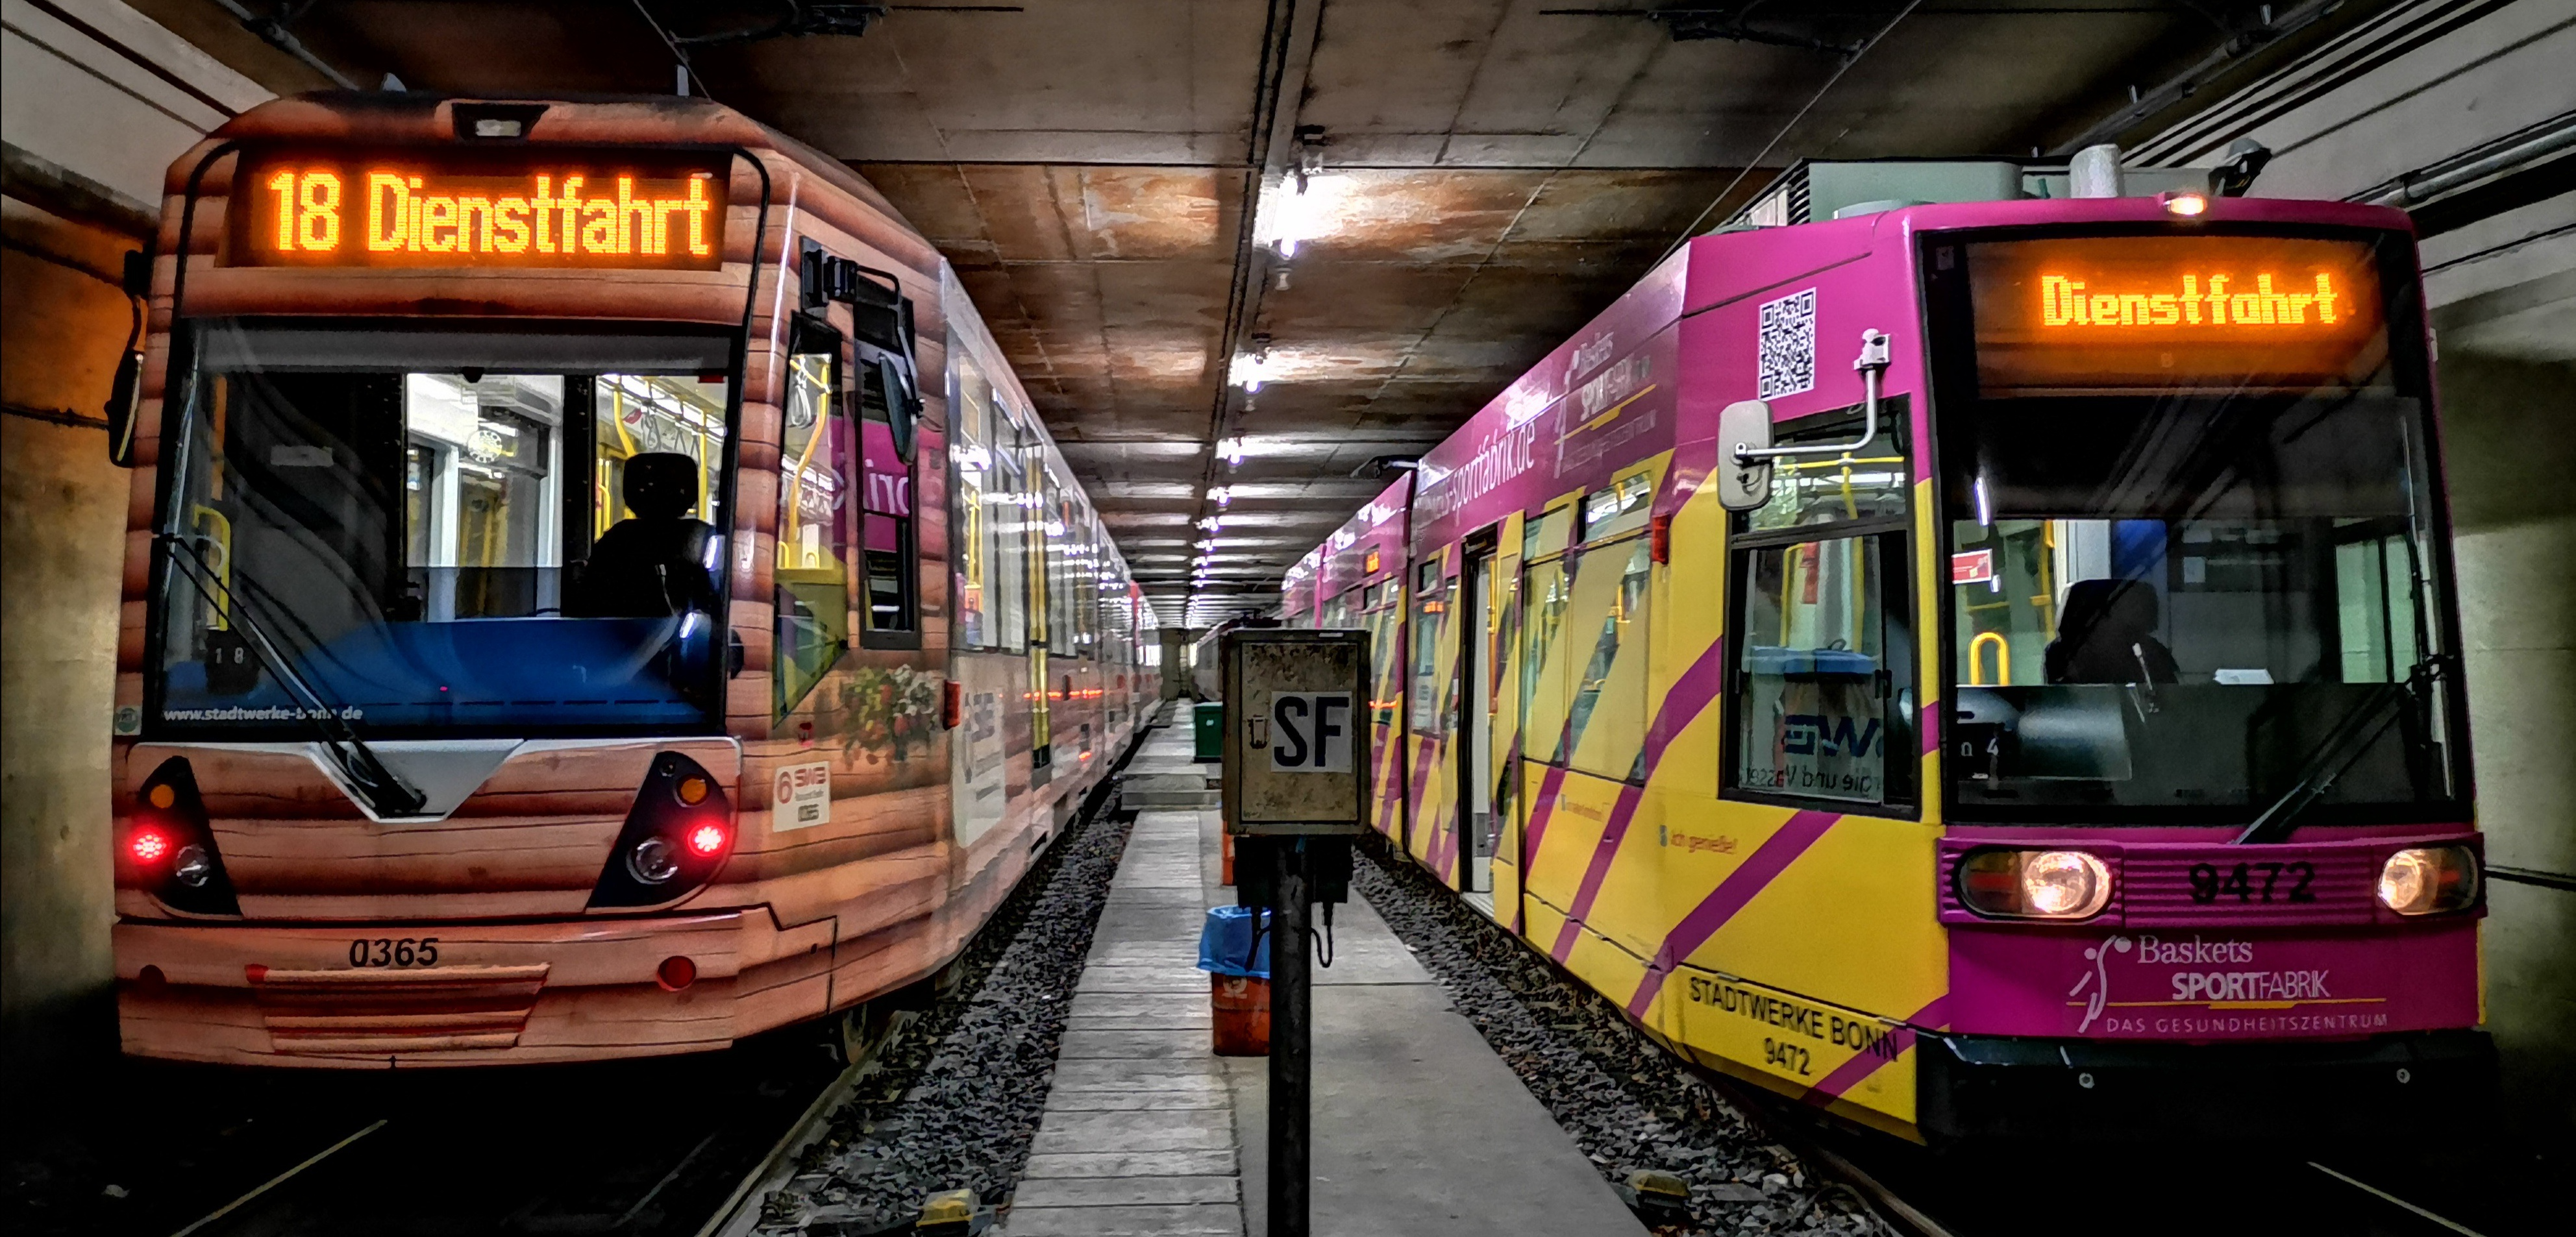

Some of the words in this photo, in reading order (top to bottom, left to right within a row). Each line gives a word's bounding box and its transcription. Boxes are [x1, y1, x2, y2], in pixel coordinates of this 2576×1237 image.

[268, 172, 340, 251] 18
[367, 173, 710, 254] Dienstfahrt
[2041, 273, 2337, 326] Dienstfahrt
[1273, 695, 1350, 768] SF
[2189, 861, 2316, 905] 9472
[349, 937, 440, 968] 0365
[2137, 935, 2253, 964] Baskets
[2172, 970, 2331, 1000] SPORTFABRIK
[1689, 976, 1824, 1040] STADTWERKE
[1830, 1014, 1898, 1062] BONN
[2106, 1018, 2146, 1033] DAS
[2156, 1014, 2388, 1033] GESUNDHEITSZENTRUM
[1764, 1037, 1811, 1076] 9472
